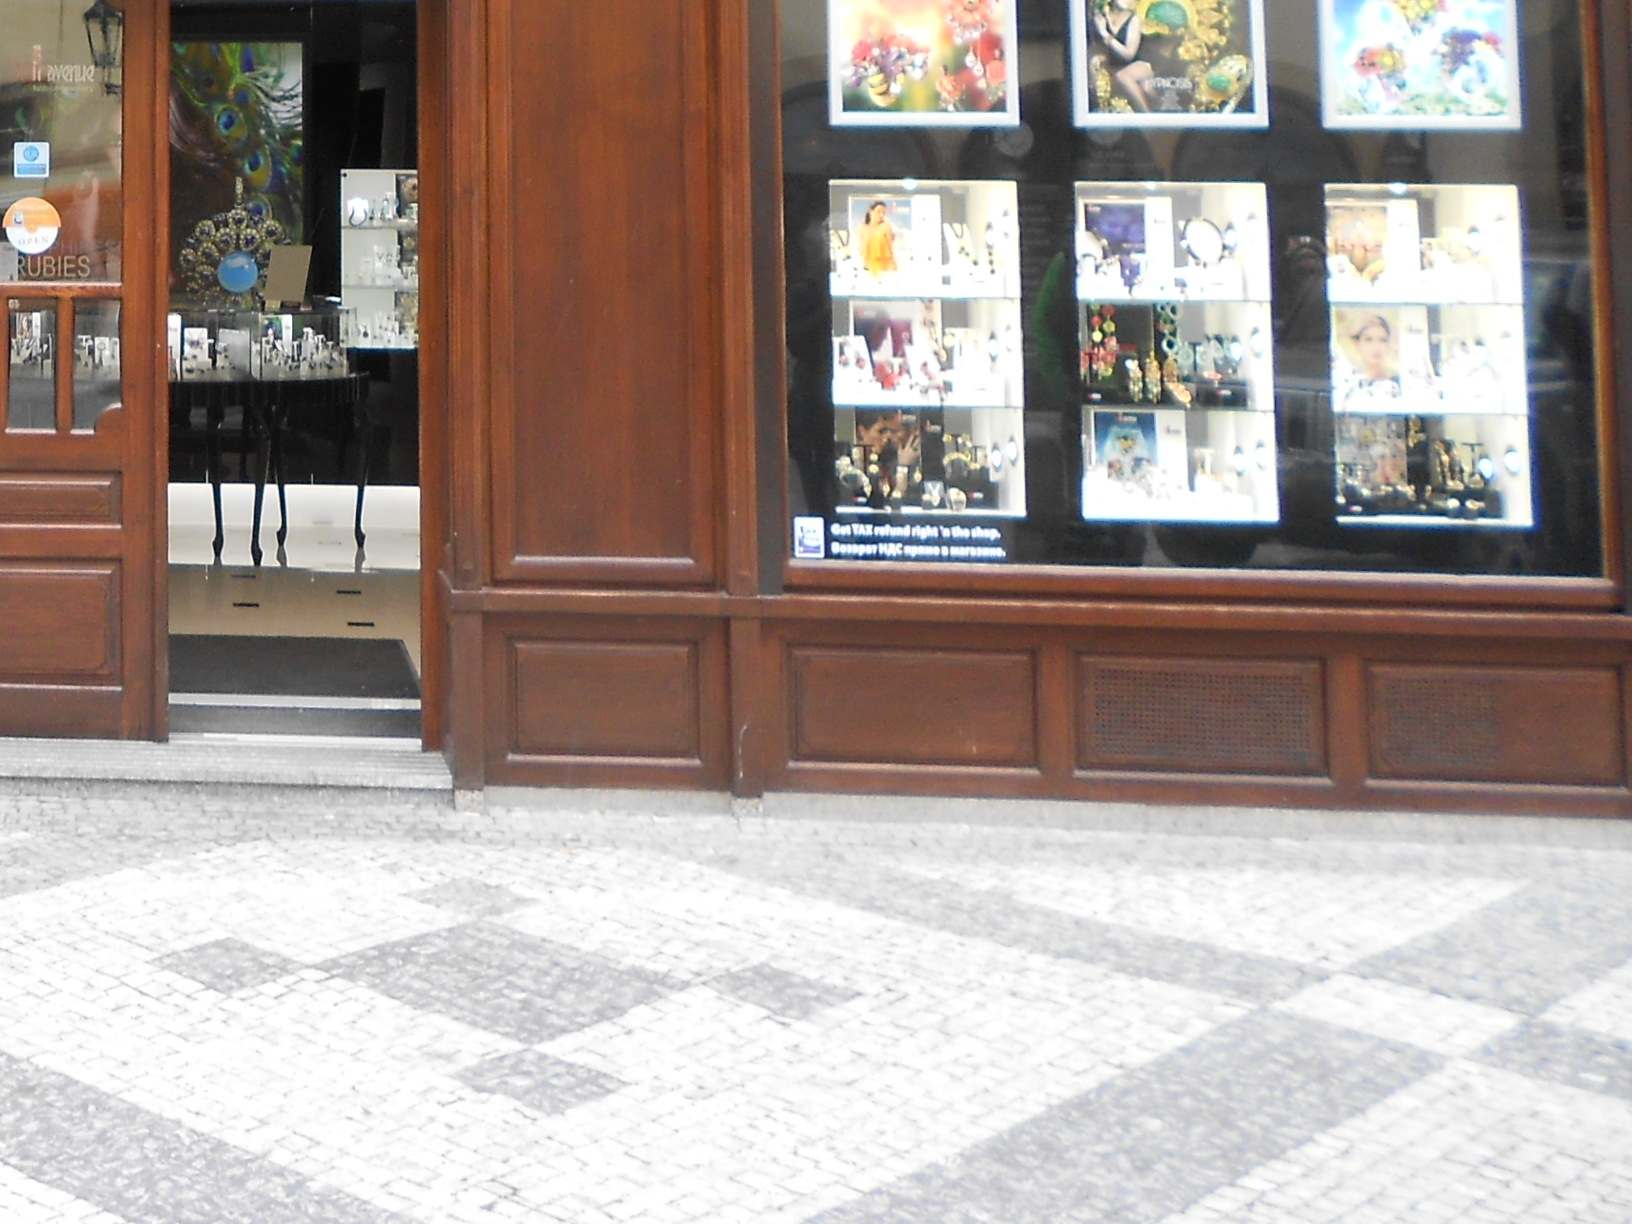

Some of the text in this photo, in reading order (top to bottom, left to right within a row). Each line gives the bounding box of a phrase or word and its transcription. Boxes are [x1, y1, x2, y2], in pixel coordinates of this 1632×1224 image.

[17, 255, 91, 277] RUBIES
[831, 523, 851, 535] Get
[851, 523, 873, 536] TAX
[874, 524, 910, 536] refund
[912, 525, 938, 539] right
[951, 526, 970, 538] the
[879, 543, 903, 556] НДС
